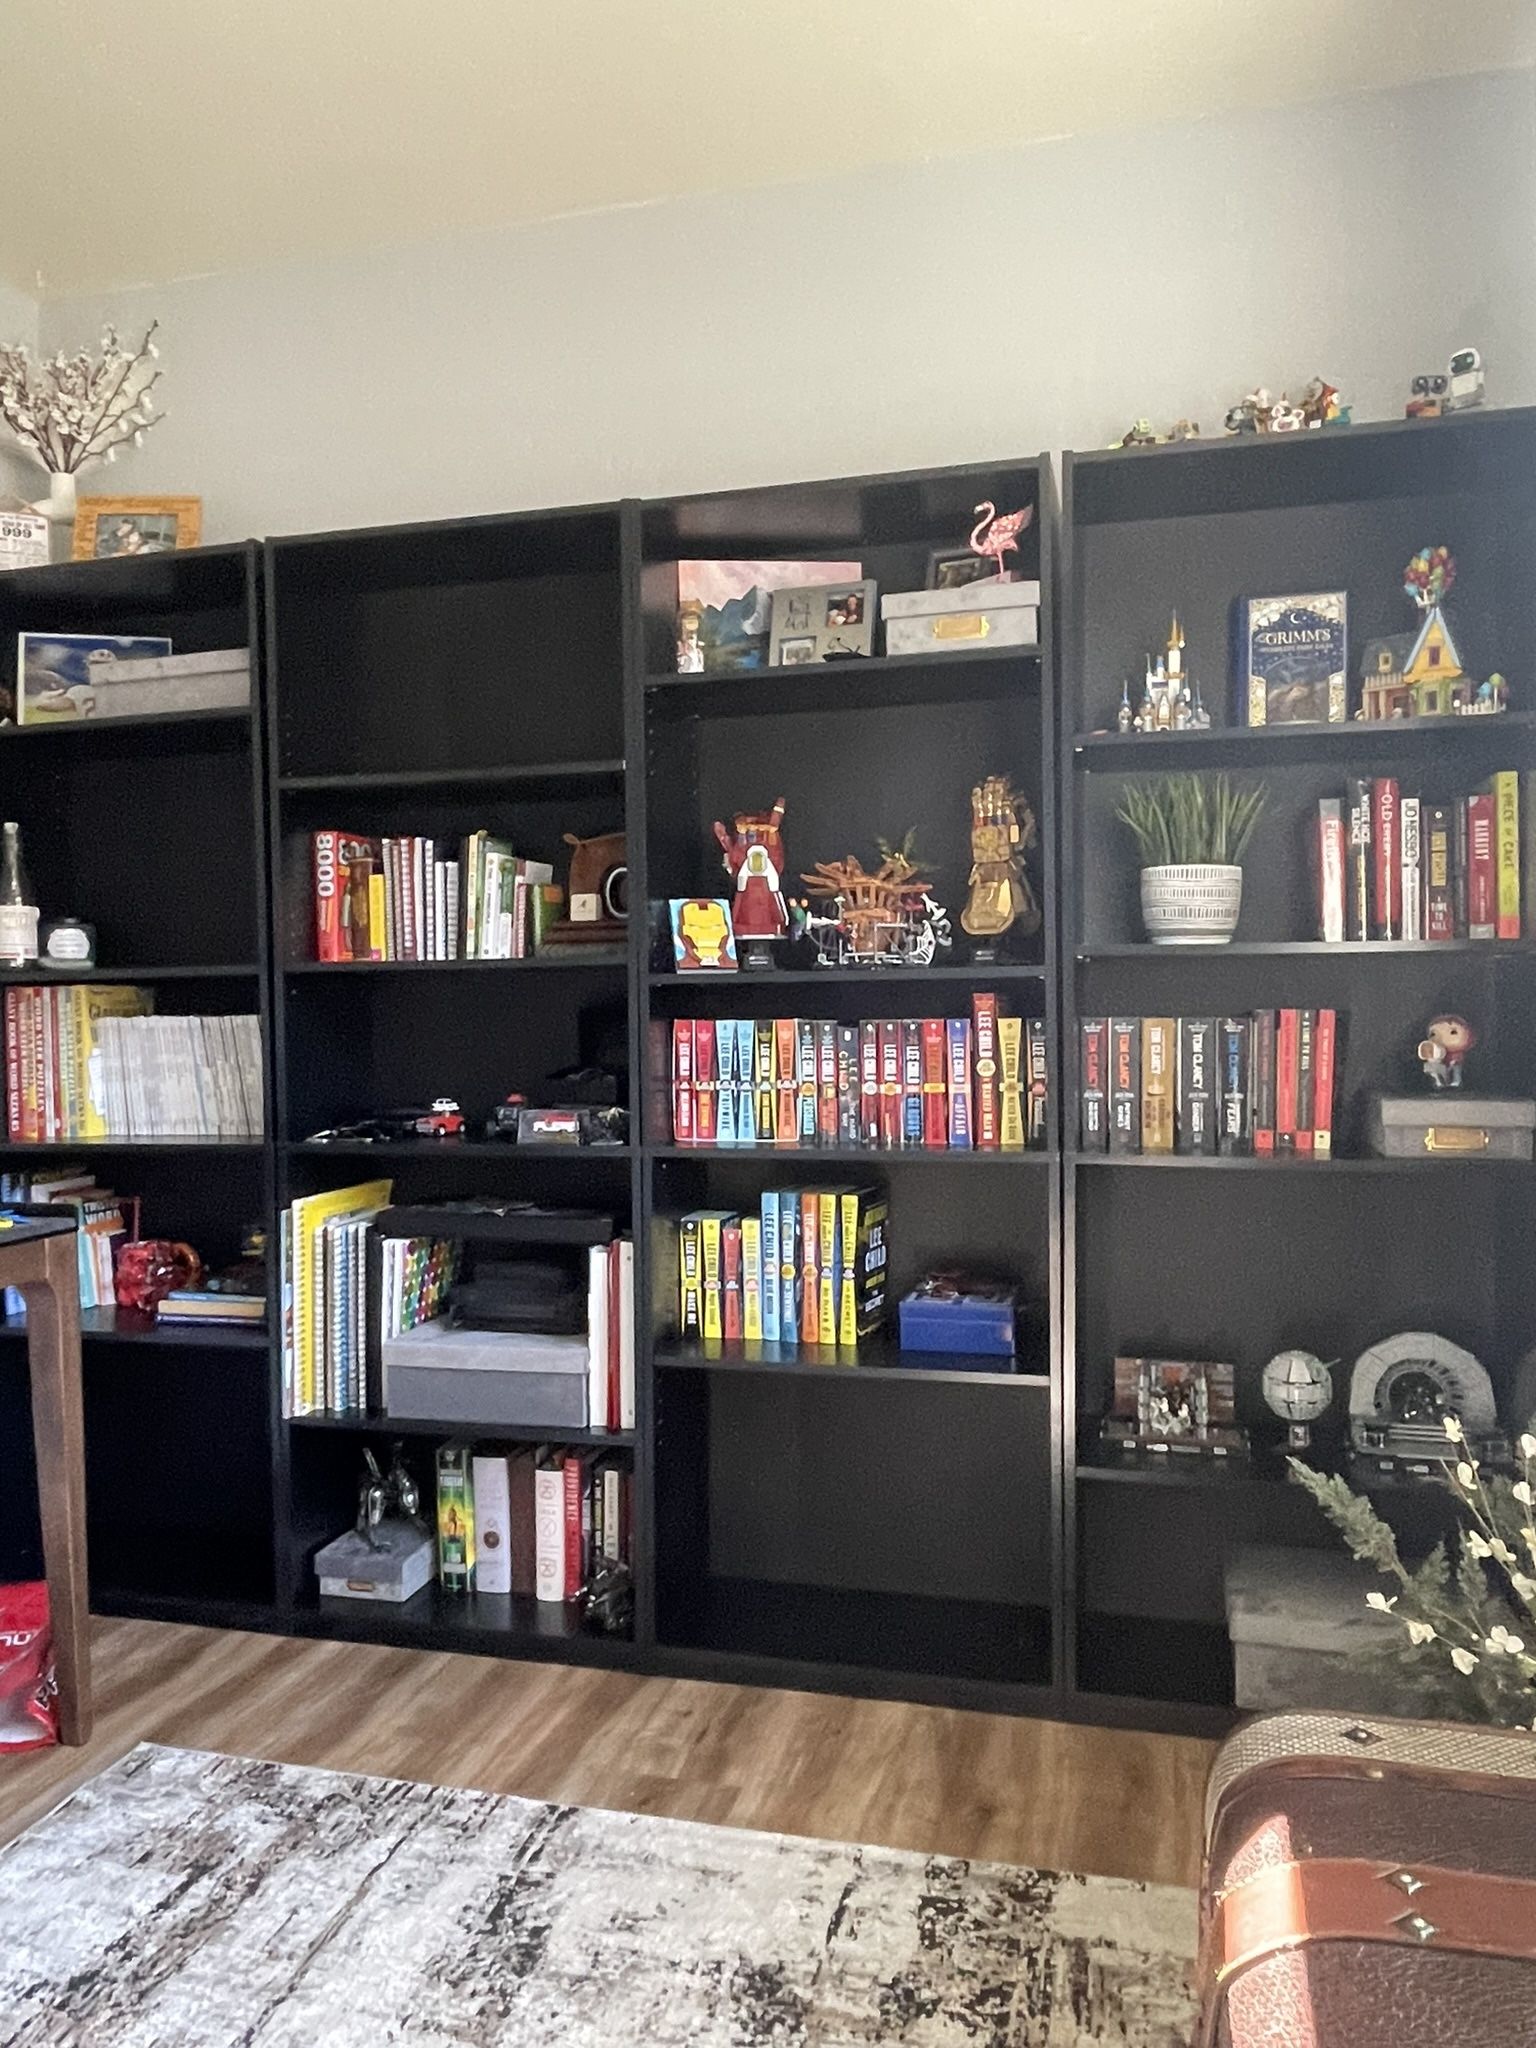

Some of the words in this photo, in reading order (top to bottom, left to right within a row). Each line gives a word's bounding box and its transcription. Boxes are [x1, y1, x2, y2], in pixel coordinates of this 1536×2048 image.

[1381, 794, 1393, 821] OLD
[1405, 802, 1417, 818] JO
[1503, 793, 1514, 822] PIECE
[1351, 808, 1360, 845] SILENCE
[317, 834, 335, 896] 8000
[35, 997, 43, 1030] WORD
[978, 1011, 992, 1029] LEE
[978, 1030, 993, 1057] CHILD
[1088, 1034, 1098, 1052] TOM
[1119, 1034, 1130, 1052] TOM
[1150, 1027, 1162, 1043] TOM
[1192, 1033, 1203, 1052] TOM
[1229, 1034, 1239, 1052] TOM
[36, 1034, 44, 1060] SEEK
[721, 1043, 731, 1054] LEE
[760, 1043, 770, 1056] LEE
[801, 1045, 814, 1059] LEE
[821, 1045, 834, 1059] LEE
[863, 1044, 876, 1058] LEE
[884, 1044, 897, 1058] LEE
[906, 1046, 920, 1060] LEE
[953, 1043, 963, 1058] LEE
[1005, 1042, 1015, 1056] LEE
[1032, 1042, 1045, 1056] LEE
[1150, 1044, 1162, 1075] CLANCY
[10, 1062, 19, 1089] WORD
[801, 1060, 814, 1081] CHILD
[821, 1060, 834, 1082] CHILD
[849, 1058, 857, 1082] LEE
[906, 1061, 920, 1084] CHILD
[1088, 1053, 1099, 1087] CLANCY
[1119, 1053, 1130, 1089] CLANCY
[1192, 1053, 1203, 1089] CLANCY
[1229, 1054, 1239, 1089] CLANCY
[37, 1063, 45, 1112] PUZZLES
[721, 1093, 731, 1129] TRIPWIRE
[954, 1103, 966, 1135] AFFAIR
[764, 1212, 775, 1228] LEE
[822, 1210, 831, 1223] LEE
[845, 1211, 854, 1224] LEE
[706, 1243, 716, 1256] LEE
[765, 1231, 775, 1258] CHILD
